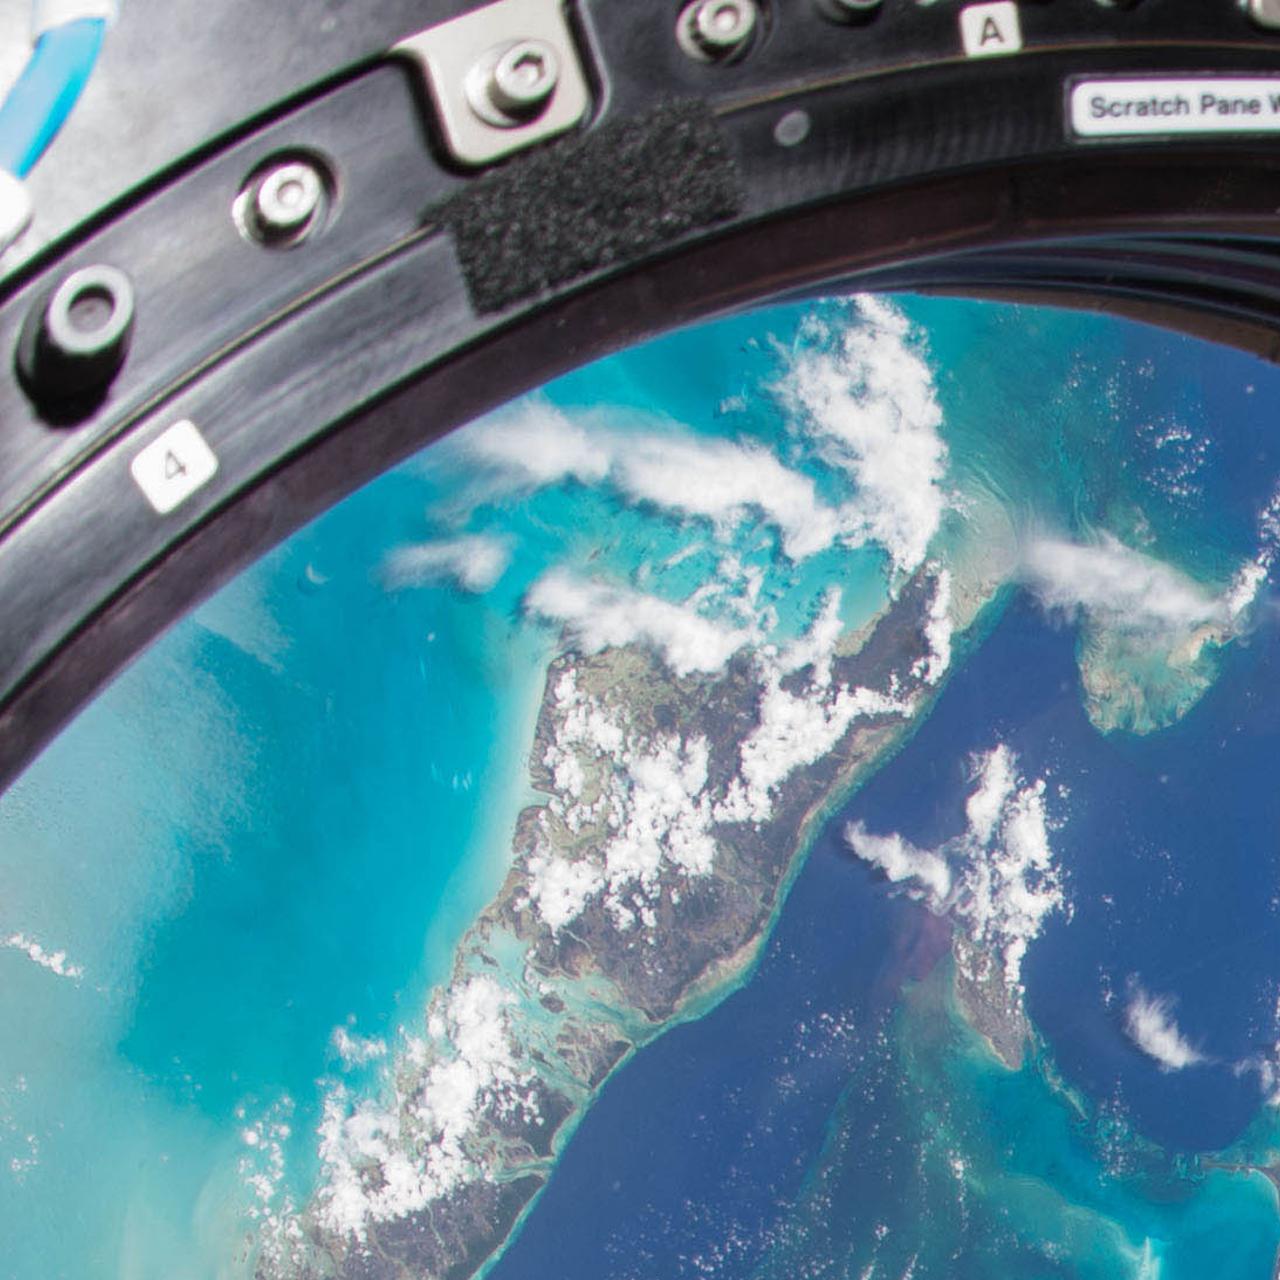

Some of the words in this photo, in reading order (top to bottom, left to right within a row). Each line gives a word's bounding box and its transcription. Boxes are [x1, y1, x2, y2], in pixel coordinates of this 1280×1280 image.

[980, 17, 1005, 46] A
[1091, 95, 1190, 118] Scratch
[1201, 94, 1262, 116] Pane
[164, 449, 187, 480] 4
